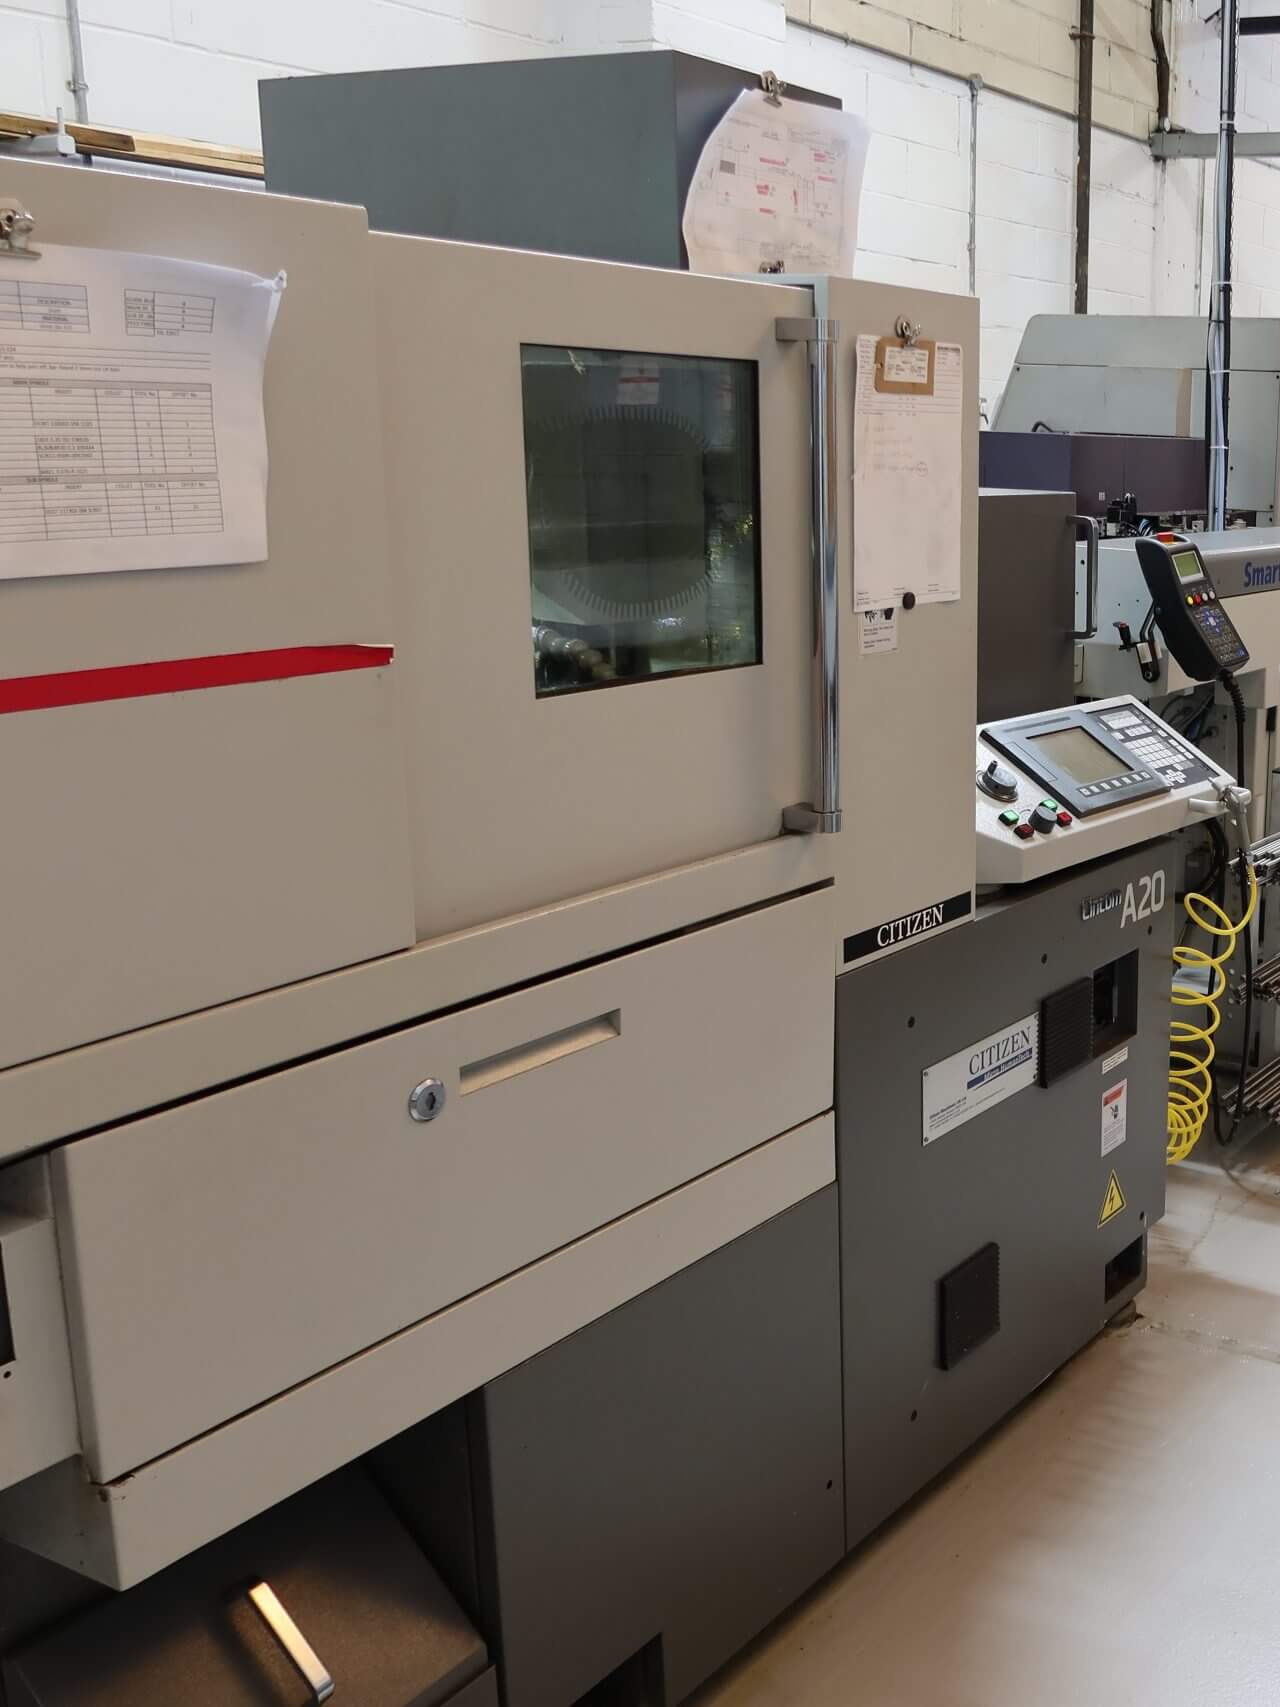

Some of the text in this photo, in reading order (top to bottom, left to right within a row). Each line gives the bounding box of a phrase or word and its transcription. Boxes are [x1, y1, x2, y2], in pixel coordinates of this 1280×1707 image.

[1120, 869, 1166, 929] A20
[876, 903, 944, 947] CITIZEN
[968, 1026, 1031, 1076] CITIZEN
